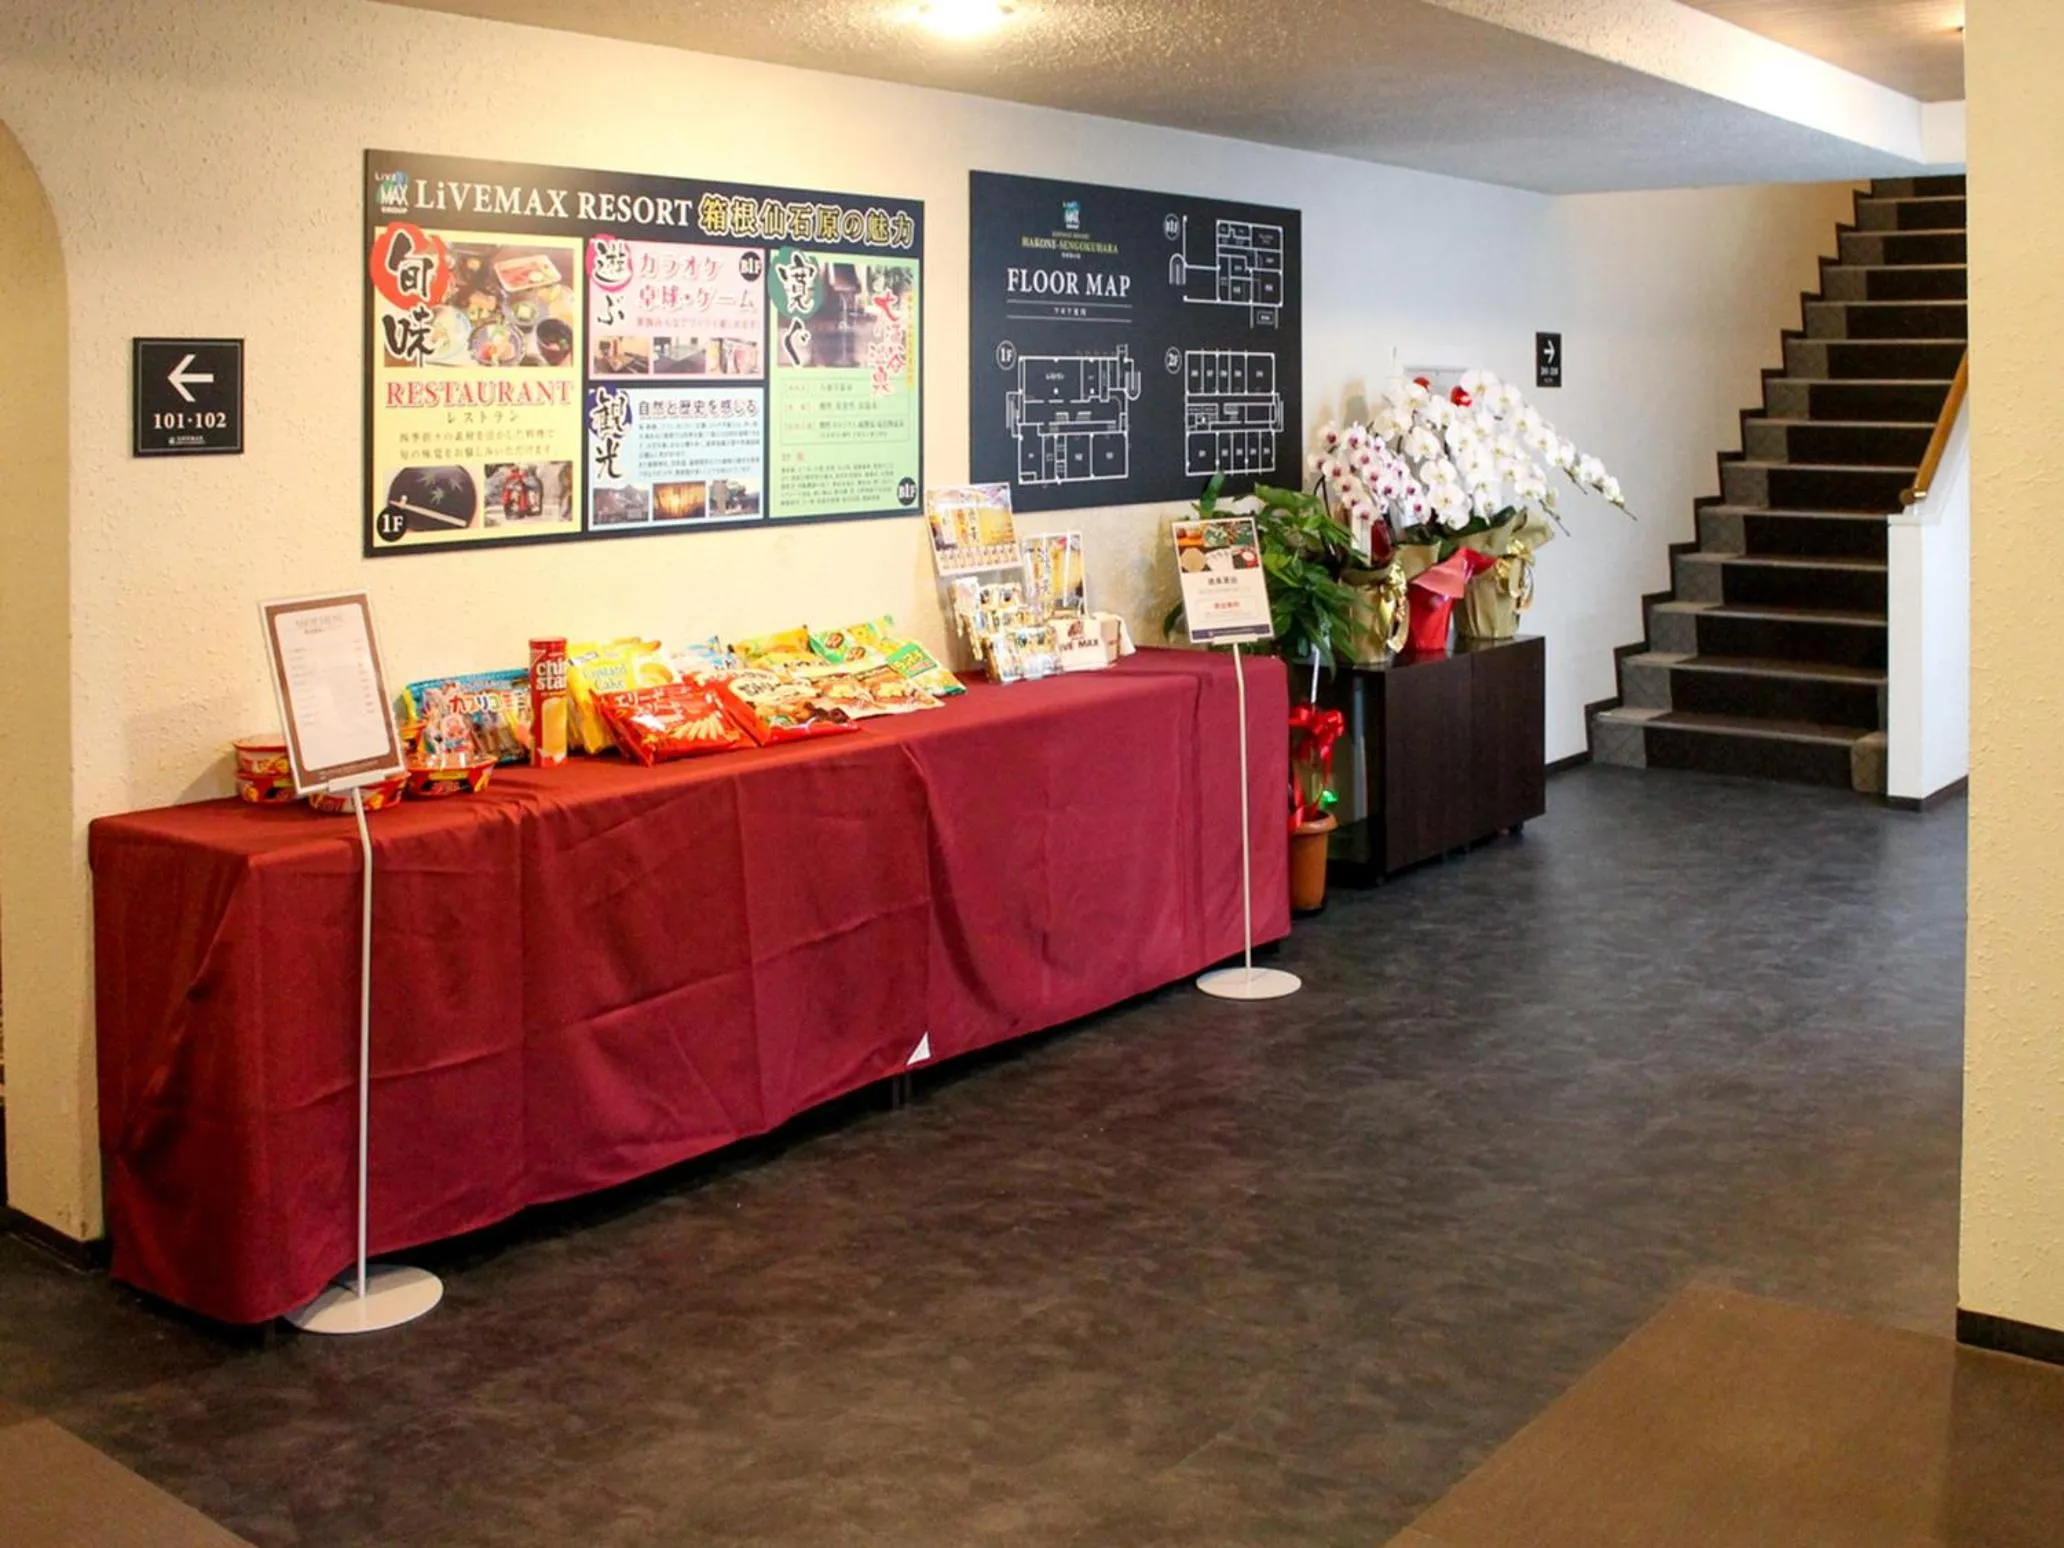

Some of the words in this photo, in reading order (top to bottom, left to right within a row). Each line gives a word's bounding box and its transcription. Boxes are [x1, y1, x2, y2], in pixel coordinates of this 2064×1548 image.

[380, 184, 409, 207] MAX
[413, 179, 569, 218] LiVEMAX
[577, 191, 693, 227] RESORT
[700, 194, 914, 248] 箱根仙石原の魅力
[640, 253, 723, 280] カラオケ
[594, 240, 629, 326] 遊ぶ
[1007, 267, 1079, 295] FLOOR
[1085, 272, 1131, 297] MAP
[382, 232, 434, 367] 旬味
[640, 285, 757, 312] 卓球・ゲーム
[1001, 348, 1012, 362] 1F
[385, 380, 574, 408] RESTAURANT
[447, 410, 519, 424] レストラン
[639, 399, 759, 418] 自然と歴史を感じる
[593, 388, 629, 479] 観光
[382, 514, 404, 533] 1F
[1078, 638, 1099, 648] MAX
